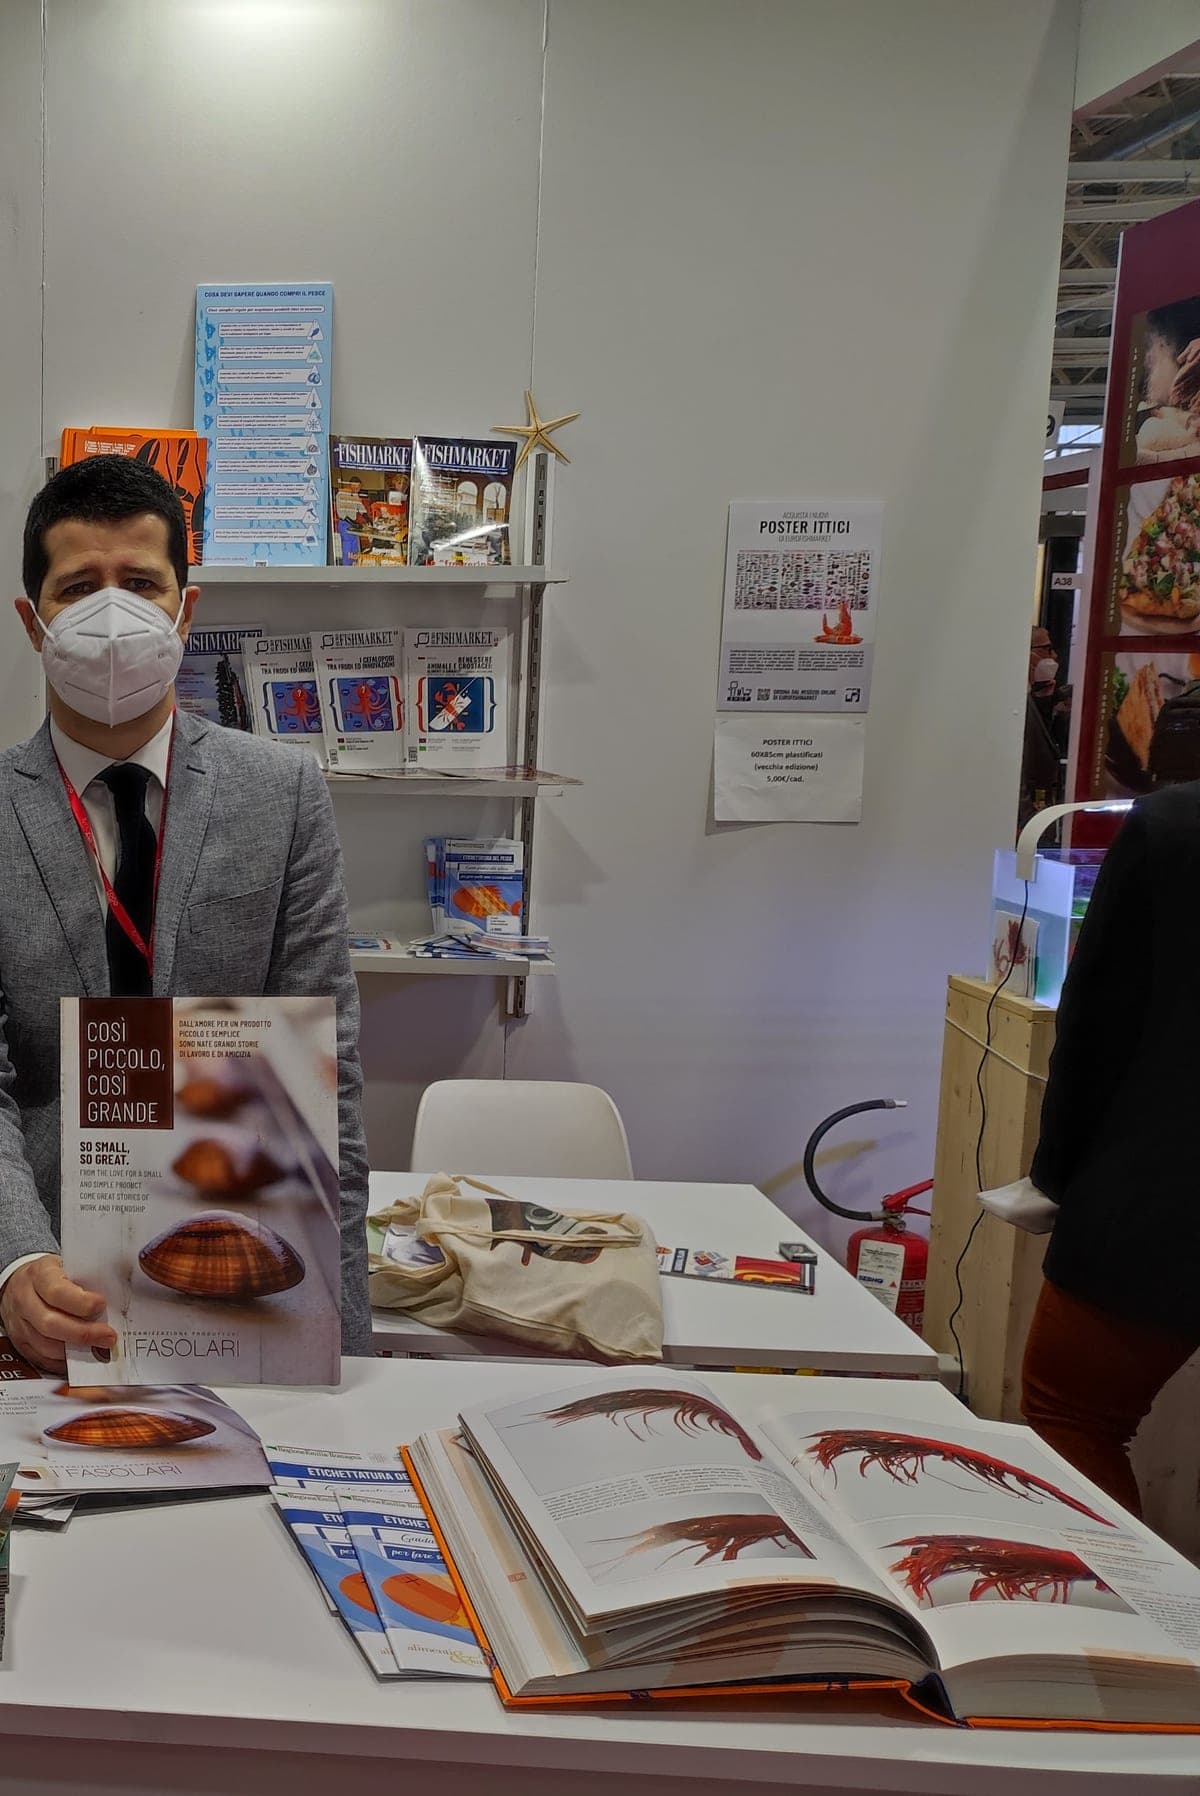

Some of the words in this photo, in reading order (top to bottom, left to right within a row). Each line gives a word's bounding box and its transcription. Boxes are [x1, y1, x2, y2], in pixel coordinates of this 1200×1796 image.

[424, 444, 511, 469] FISHMARKET
[759, 520, 809, 534] POSTER
[813, 520, 851, 534] ITTICI
[338, 630, 394, 646] FISHMARKET
[436, 631, 493, 645] FISHMARKET
[785, 751, 823, 759] plastificati
[754, 763, 783, 771] (vecchia
[784, 763, 819, 771] edizione)
[766, 775, 805, 783] 5,00€/cad.
[87, 1016, 127, 1043] COSÌ
[216, 1020, 229, 1028] PER
[229, 1020, 239, 1028] UN
[240, 1020, 272, 1028] PRODOTTO
[179, 1030, 205, 1038] PICCOLO
[205, 1030, 210, 1038] E
[211, 1030, 241, 1038] SEMPLICE
[179, 1040, 196, 1048] SONO
[196, 1040, 212, 1048] NATE
[213, 1040, 237, 1048] GRANDI
[238, 1040, 260, 1048] STORIE
[87, 1048, 166, 1072] PICCOLO,
[179, 1050, 186, 1058] DI
[186, 1050, 211, 1058] LAVORO
[216, 1050, 224, 1058] DI
[225, 1050, 252, 1058] AMICIZIA
[87, 1070, 127, 1096] COSÌ
[87, 1102, 159, 1123] GRANDE
[80, 1141, 93, 1154] SO
[95, 1141, 130, 1155] SMALL,
[80, 1153, 93, 1166] SO
[95, 1153, 130, 1166] GREAT.
[80, 1169, 96, 1177] FROM
[97, 1169, 108, 1177] THE
[125, 1170, 137, 1178] FOR
[143, 1170, 163, 1178] SMALL
[80, 1181, 93, 1189] AND
[93, 1181, 114, 1189] SIMPLE
[115, 1181, 142, 1189] PRODUCT
[80, 1192, 96, 1200] COME
[96, 1192, 116, 1200] GREAT
[116, 1193, 141, 1201] STORIES
[141, 1193, 150, 1201] OF
[80, 1204, 97, 1212] WORK
[111, 1205, 146, 1213] FRIENDSHIP
[135, 1338, 240, 1358] FASOLARI
[64, 1464, 183, 1479] FASOLARI
[307, 1467, 394, 1481] ETICHETTATURA
